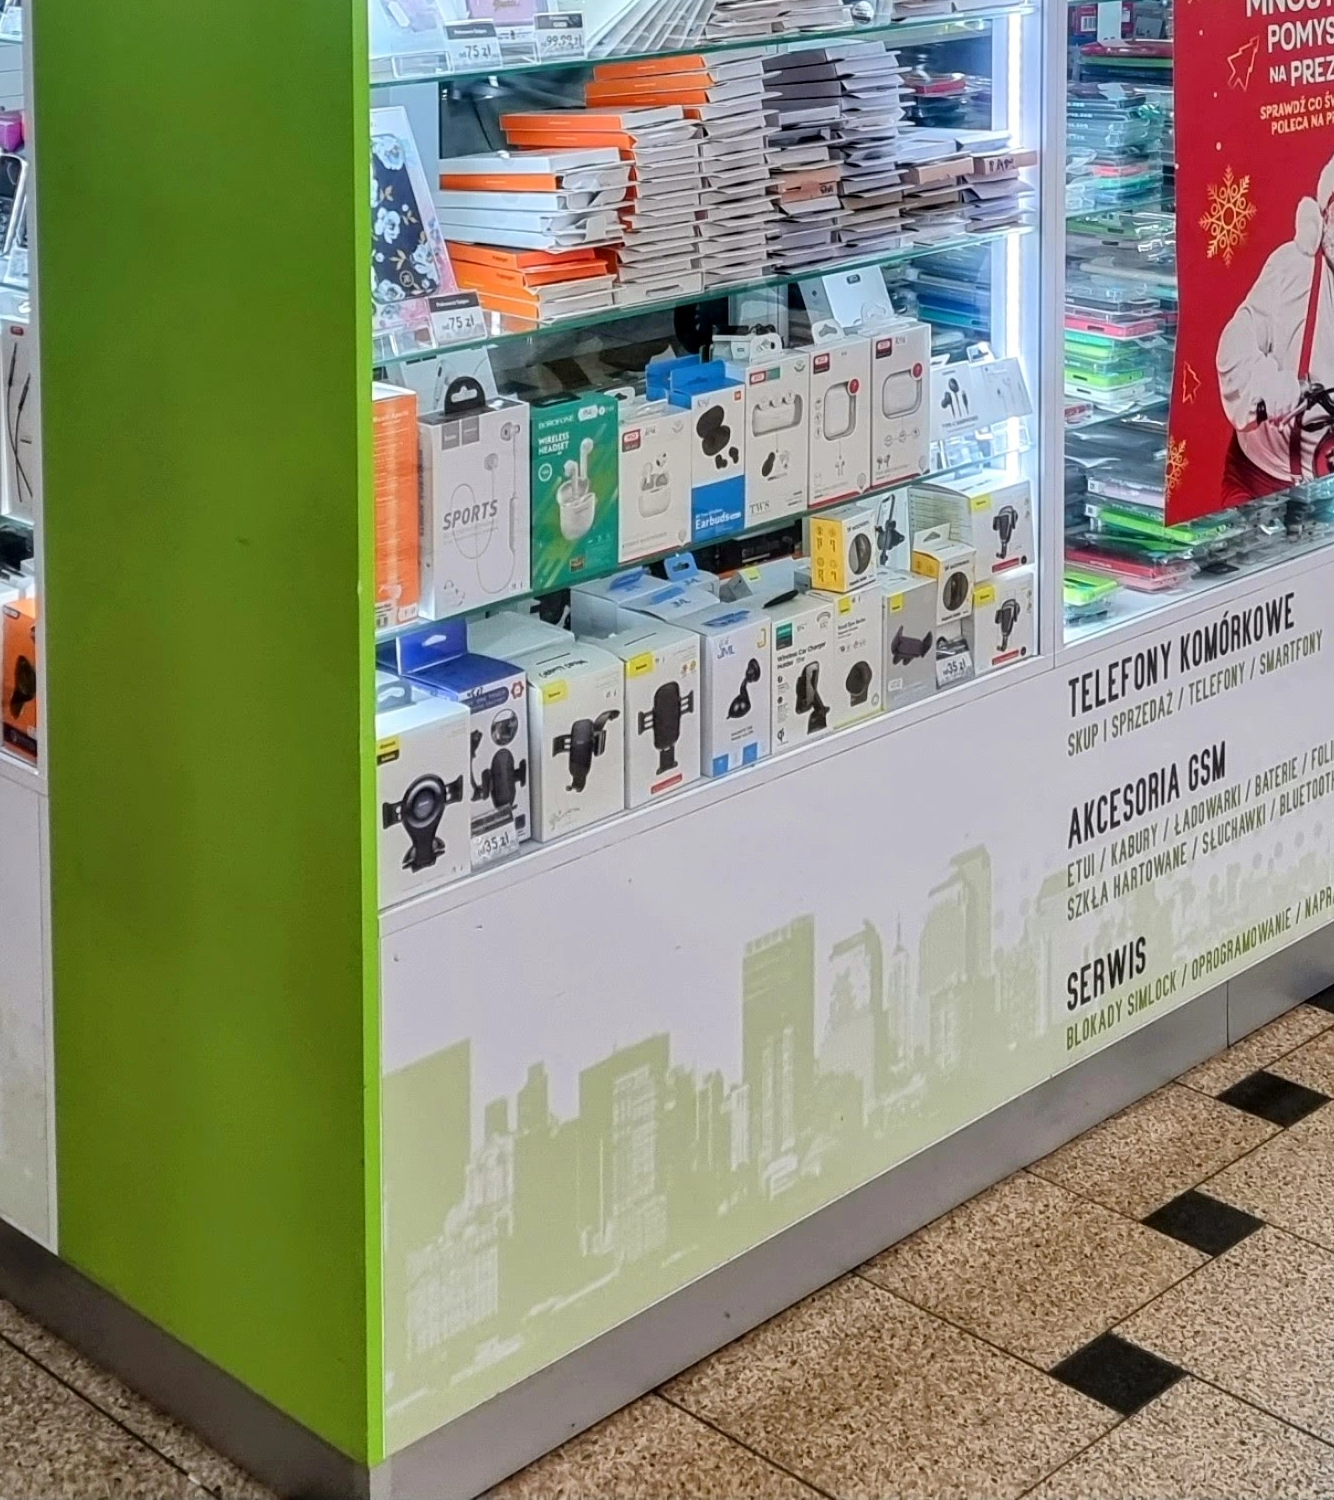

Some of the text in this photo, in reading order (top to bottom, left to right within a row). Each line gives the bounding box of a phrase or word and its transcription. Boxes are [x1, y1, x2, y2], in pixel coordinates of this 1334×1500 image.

[1269, 66, 1287, 84] NA
[1260, 95, 1306, 120] SPRAWDŹ
[1308, 96, 1322, 112] CO
[1271, 115, 1309, 135] POLECA
[1311, 114, 1324, 128] NA
[448, 316, 462, 329] 75
[538, 432, 570, 446] WIRELESS
[538, 440, 570, 455] HEADSET
[443, 499, 498, 530] SPORTS
[695, 512, 730, 530] Earbuds
[1068, 592, 1295, 718] TELEFONY KOMÓRKOWE
[1067, 722, 1098, 757] SKUP
[1112, 689, 1173, 739] SPRZEDAŻ
[1188, 661, 1245, 706] TELEFONY
[1259, 629, 1323, 675] SMARTFONY
[1068, 740, 1226, 849] AKCESORIA GSM
[1067, 853, 1095, 888] ETUI
[1111, 821, 1158, 867] KABURY
[1173, 784, 1241, 836] ŁADOWARKI
[1255, 757, 1298, 797] BATERIE
[1067, 880, 1109, 921] SZKŁA
[1113, 841, 1187, 899] HARTOWANE
[1202, 803, 1266, 855] SŁUCHAWKI
[1067, 936, 1146, 1011] SERWIS
[1067, 999, 1123, 1051] BLOKADY
[1127, 969, 1177, 1016] SIMLOCK
[1192, 907, 1292, 981] OPROGRAMOWANIE
